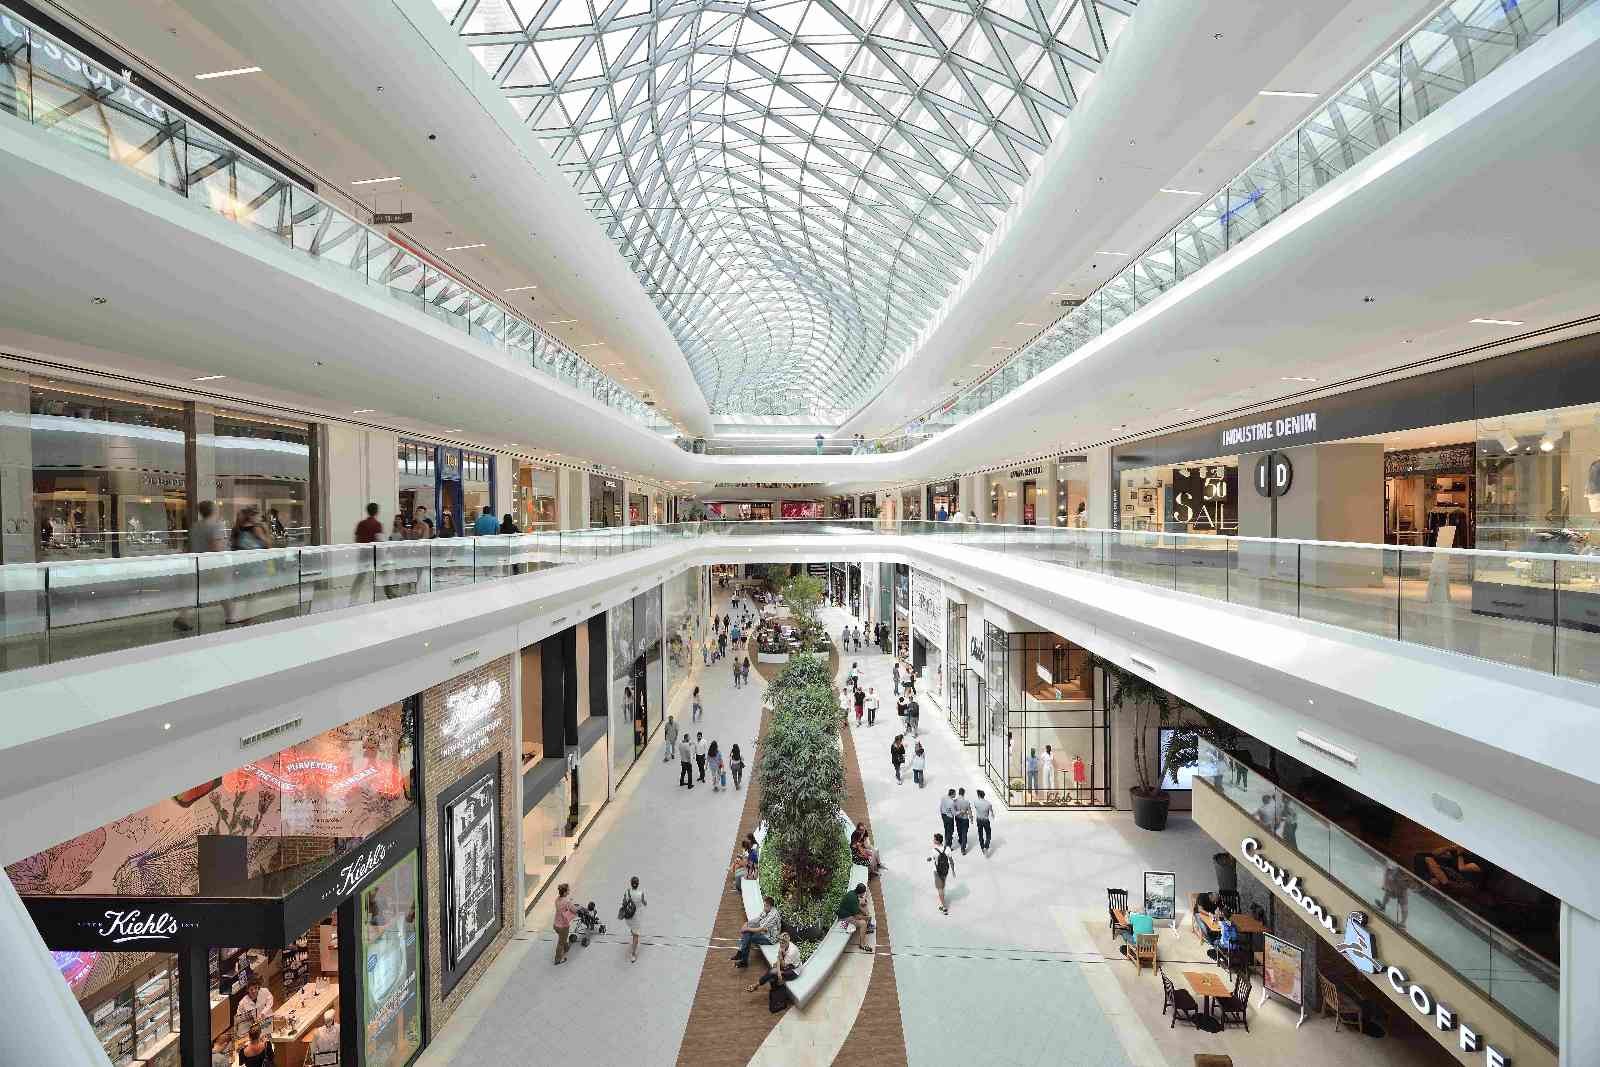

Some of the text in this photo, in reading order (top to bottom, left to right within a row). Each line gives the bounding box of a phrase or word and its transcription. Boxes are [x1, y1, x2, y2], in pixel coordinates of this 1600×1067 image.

[1222, 412, 1317, 446] INDUSTRIE DENIM
[337, 843, 386, 896] Kiehl's
[1241, 837, 1338, 935] Caribou
[100, 909, 178, 943] Kiehl's
